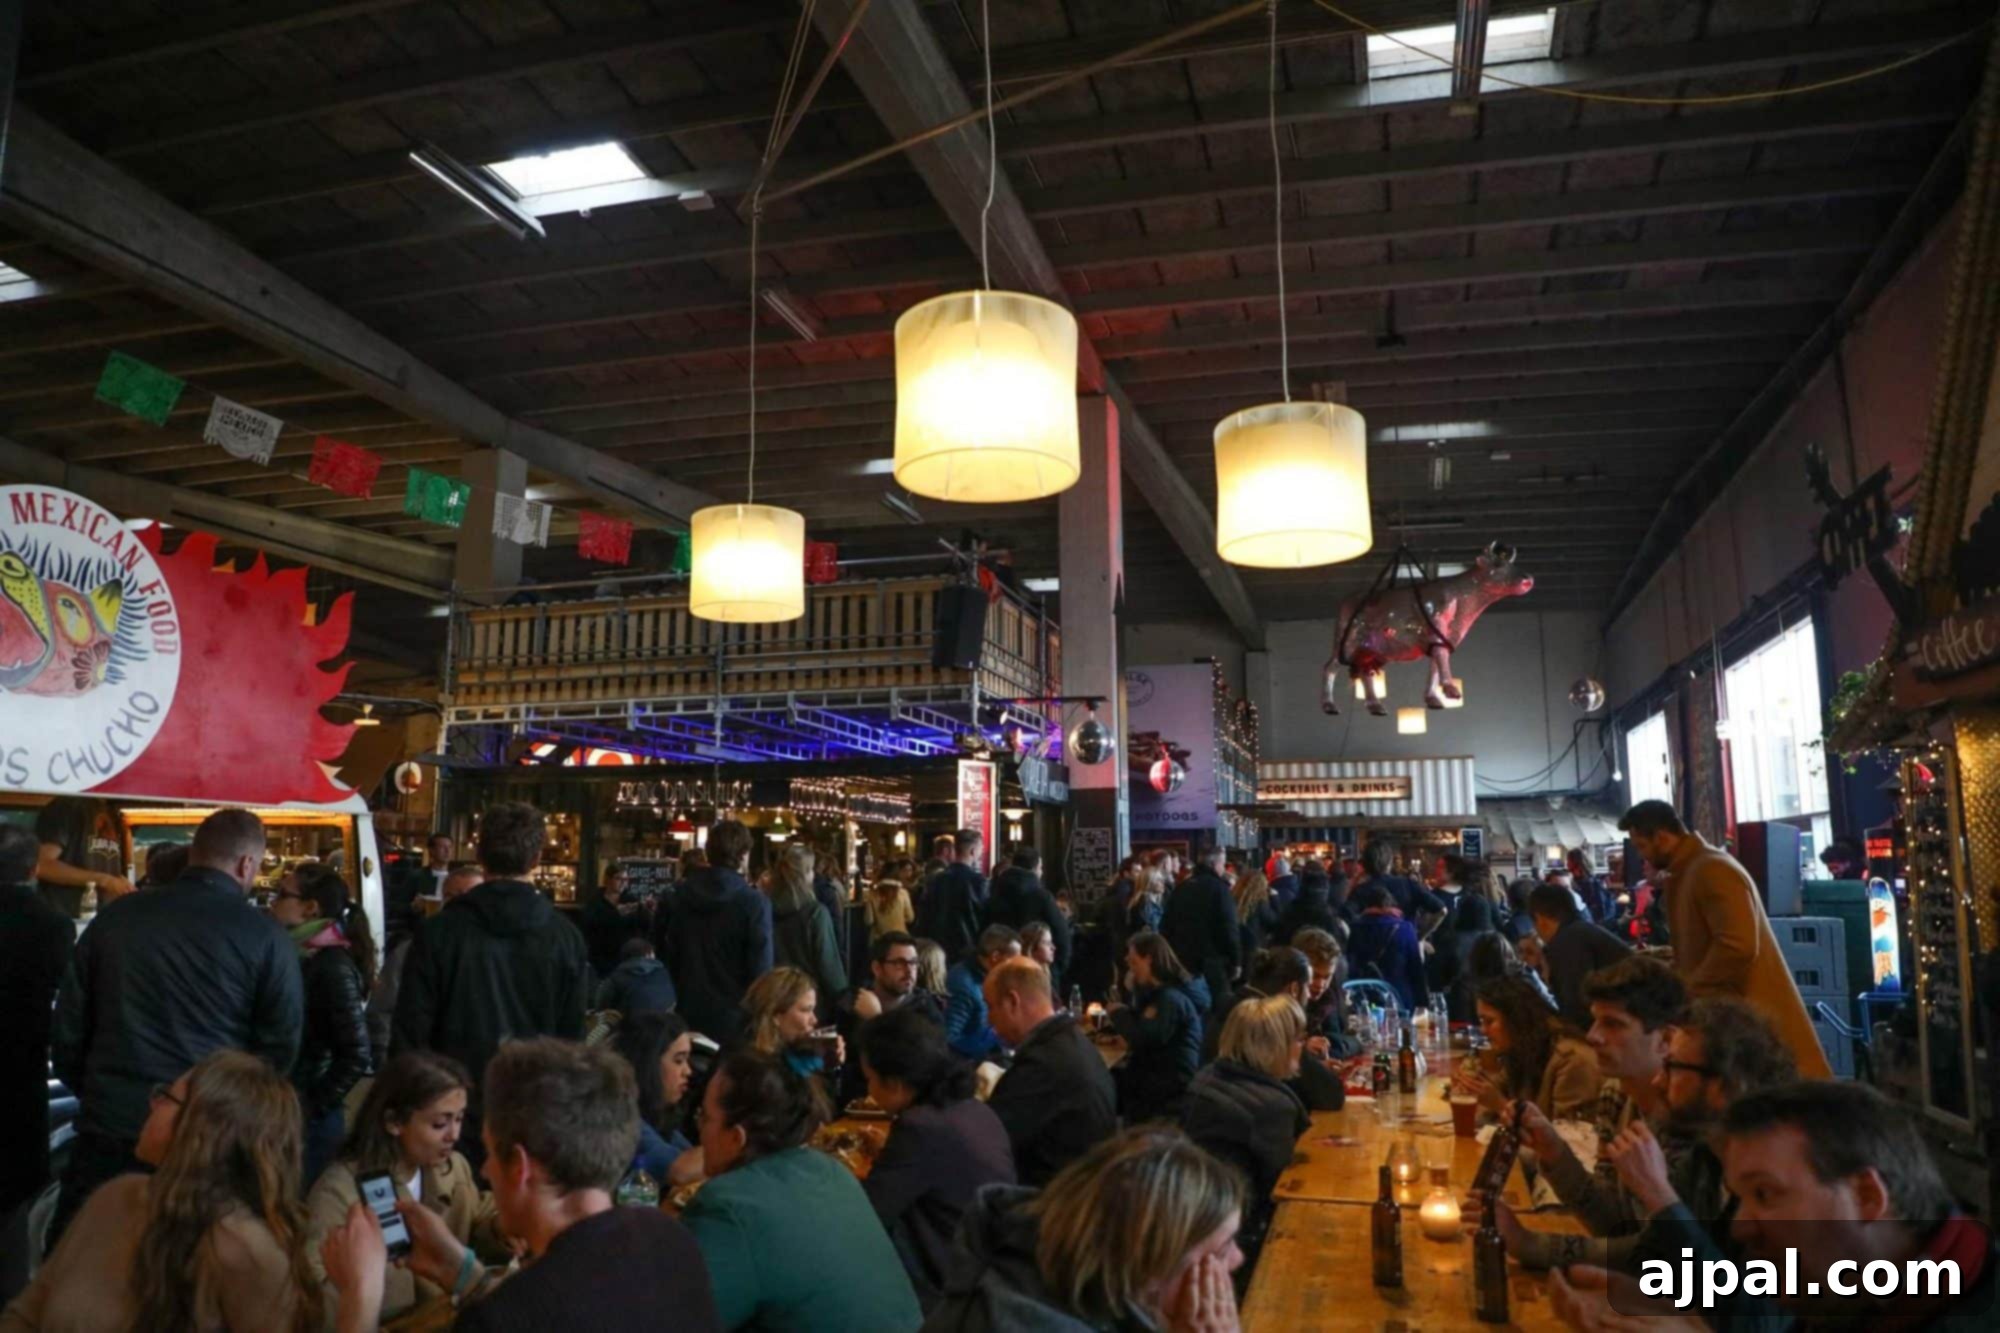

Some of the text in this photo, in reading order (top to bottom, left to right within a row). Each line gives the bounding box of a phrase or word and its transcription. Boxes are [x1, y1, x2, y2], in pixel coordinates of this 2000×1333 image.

[9, 491, 178, 656] MEXICAN FOOD
[0, 690, 160, 786] S CHUCHO
[1265, 782, 1395, 794] COCKTAILS & DRINKS
